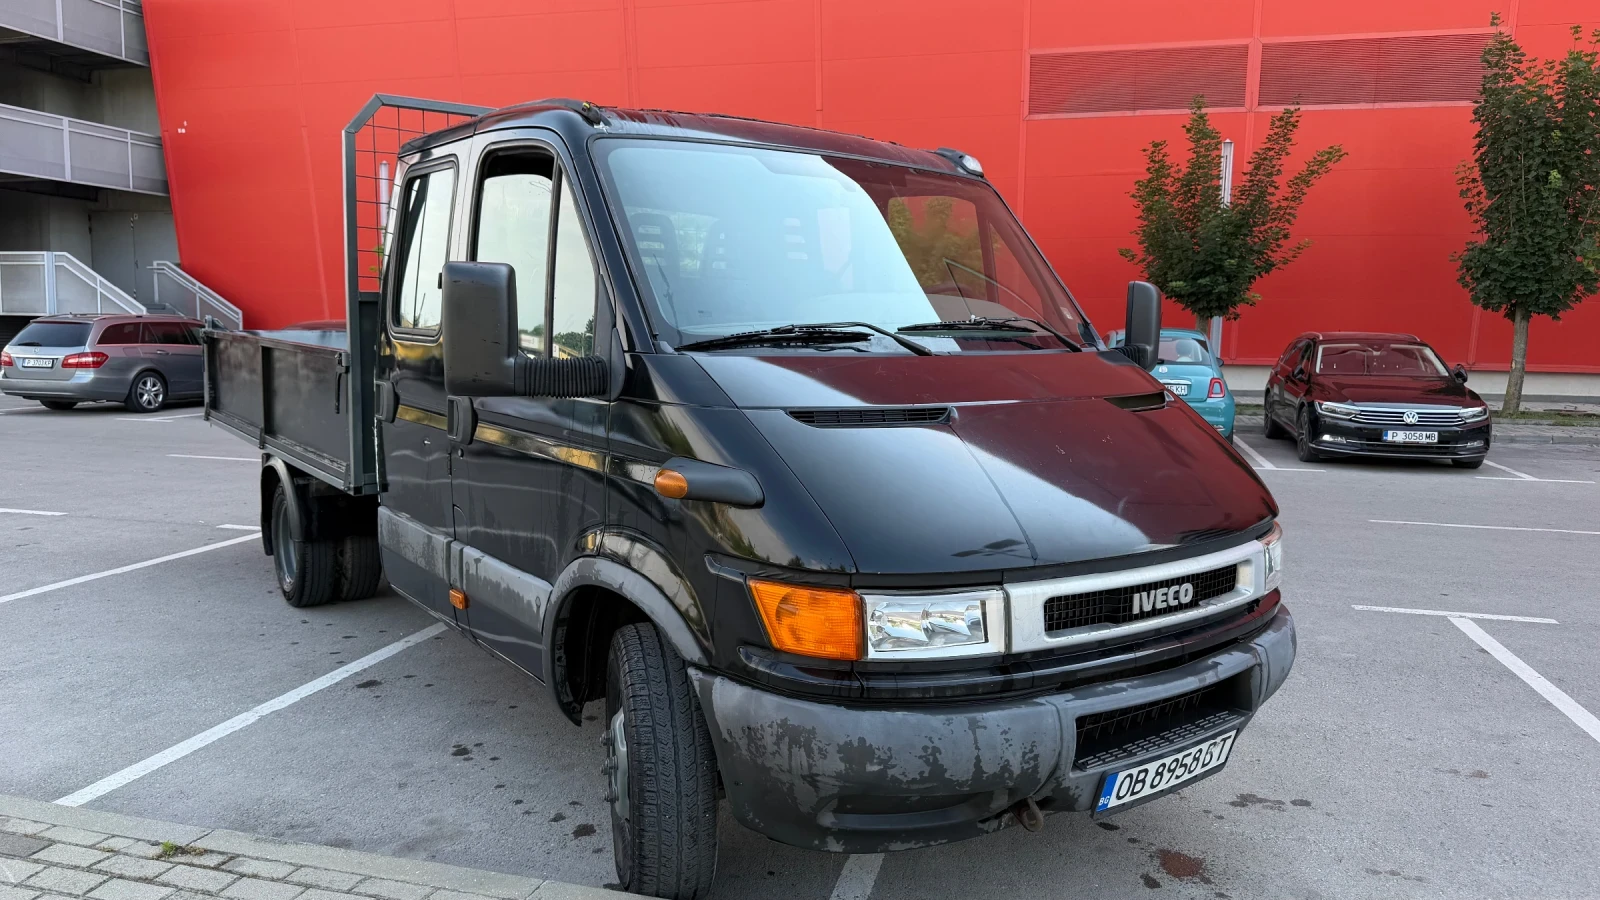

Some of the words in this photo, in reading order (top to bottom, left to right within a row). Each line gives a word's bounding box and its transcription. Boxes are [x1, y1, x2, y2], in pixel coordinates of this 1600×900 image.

[1392, 432, 1398, 440] P
[1402, 432, 1423, 441] 3058
[1425, 432, 1436, 441] MB
[1132, 582, 1194, 614] IVECO
[1115, 768, 1149, 800] OB
[1150, 748, 1202, 790] 8958
[1098, 796, 1110, 806] BG
